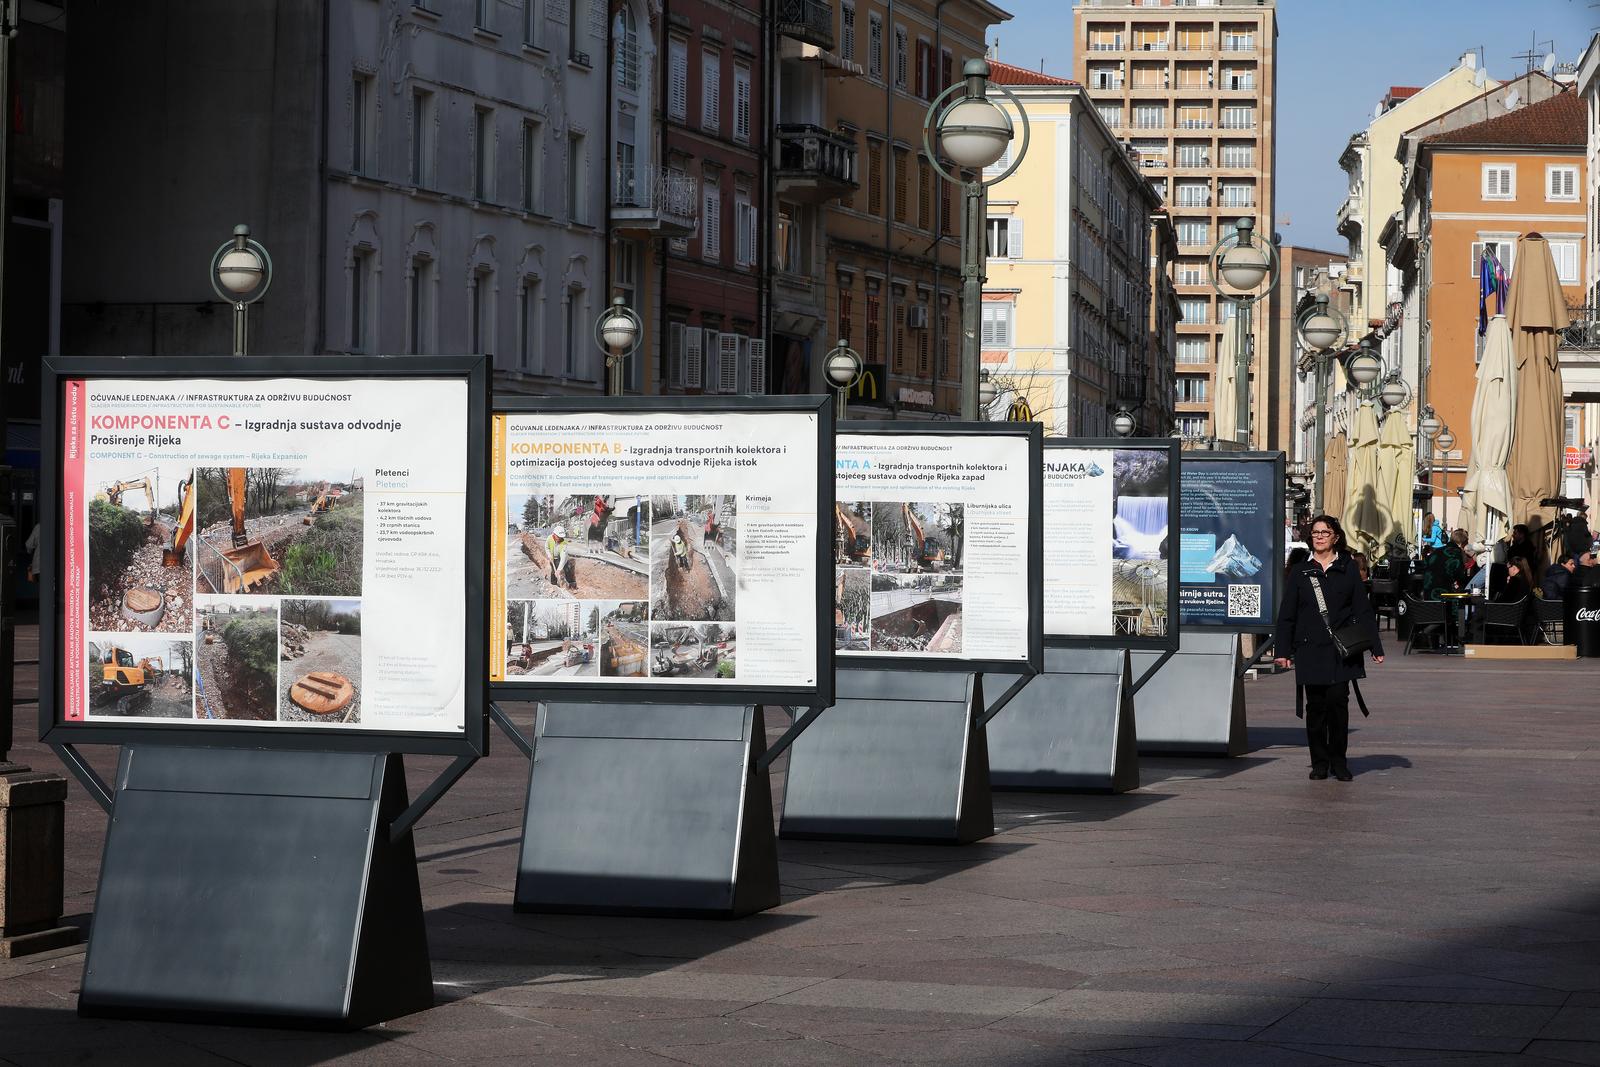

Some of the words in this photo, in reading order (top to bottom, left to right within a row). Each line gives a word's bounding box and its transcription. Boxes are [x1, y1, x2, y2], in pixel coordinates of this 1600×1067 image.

[90, 393, 130, 401] OČUVANJE
[267, 393, 301, 401] ODRŽIVU
[303, 393, 352, 401] BUDUĆNOST
[91, 415, 212, 430] KOMPONENTA
[218, 415, 230, 430] C
[245, 419, 297, 432] Izgradnja
[300, 420, 344, 430] sustava
[347, 419, 402, 432] odvodnje
[91, 435, 145, 447] Proširenje
[148, 435, 181, 447] Rijeka
[511, 443, 609, 454] KOMPONENTA
[614, 443, 622, 454] B
[630, 445, 673, 456] Izgradnja
[675, 445, 734, 455] transportnih
[736, 445, 781, 454] kolektora
[783, 446, 787, 454] i
[251, 453, 271, 461] Rijeka
[272, 453, 308, 461] Expansion
[510, 458, 566, 468] optimizacija
[568, 458, 617, 468] postojećeg
[657, 458, 701, 468] odvodnje
[703, 458, 732, 468] Rijeka
[734, 458, 758, 466] istok
[863, 460, 871, 469] A
[878, 462, 914, 471] Izgradnja
[916, 463, 964, 471] transportnih
[898, 473, 935, 481] odvodnje
[936, 474, 960, 482] Rijeka
[962, 474, 985, 482] zapad
[376, 480, 408, 488] Pletenci
[1203, 590, 1226, 598] sutra.
